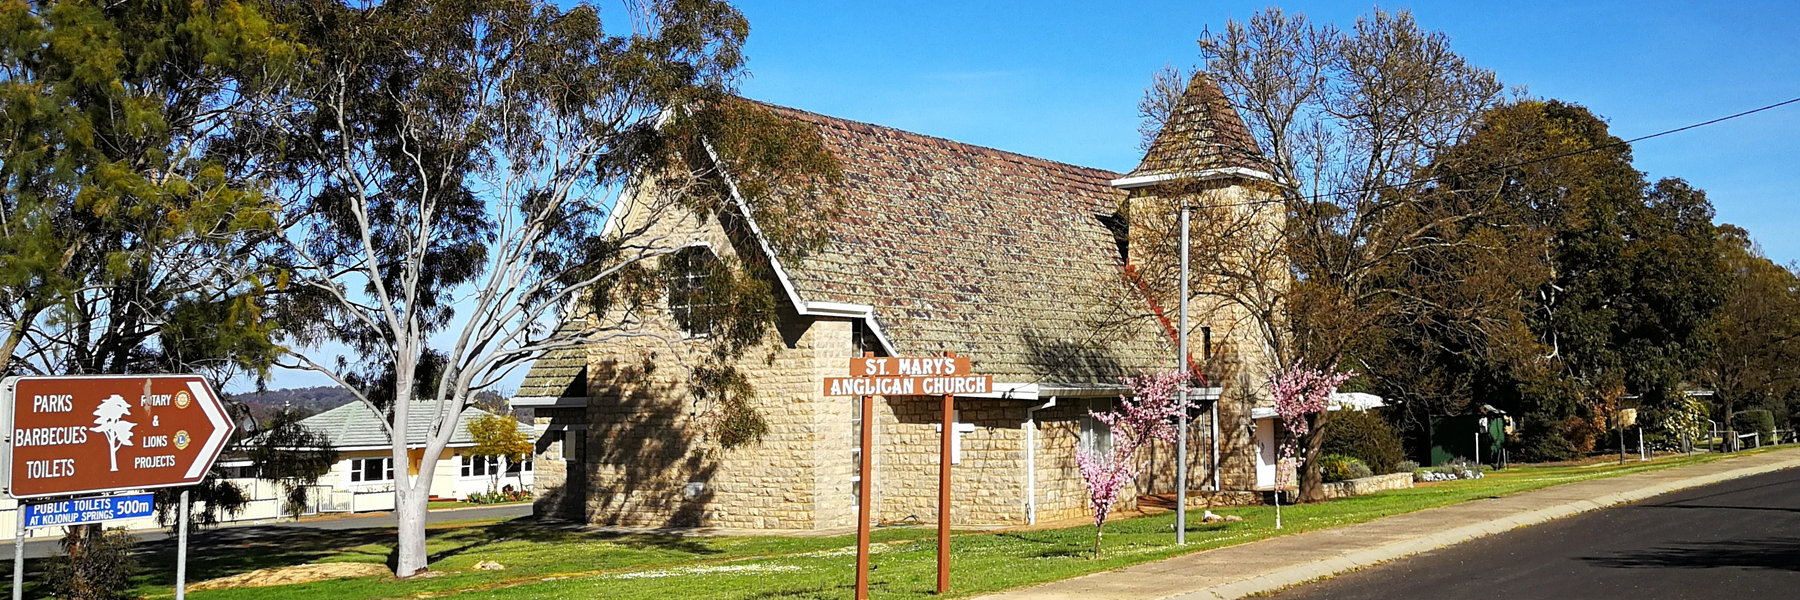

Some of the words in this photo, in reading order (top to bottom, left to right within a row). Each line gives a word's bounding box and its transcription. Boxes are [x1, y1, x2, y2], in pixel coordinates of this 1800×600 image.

[865, 358, 890, 375] ST.
[830, 378, 914, 396] ANGLICAN
[922, 376, 987, 394] CHURCH
[33, 394, 73, 413] PARKS
[140, 394, 172, 407] RTARY
[152, 415, 160, 427] &
[15, 426, 88, 447] BARBECUES
[143, 435, 168, 448] LIONS
[26, 458, 75, 479] TOILETS
[134, 455, 176, 469] PROJECTS
[33, 502, 69, 515] PUBLIC
[74, 498, 111, 512] TOILETS
[117, 500, 149, 515] 500m
[29, 515, 40, 526] AT
[42, 512, 79, 525] KOJONUP
[81, 510, 113, 521] SPRINGS
